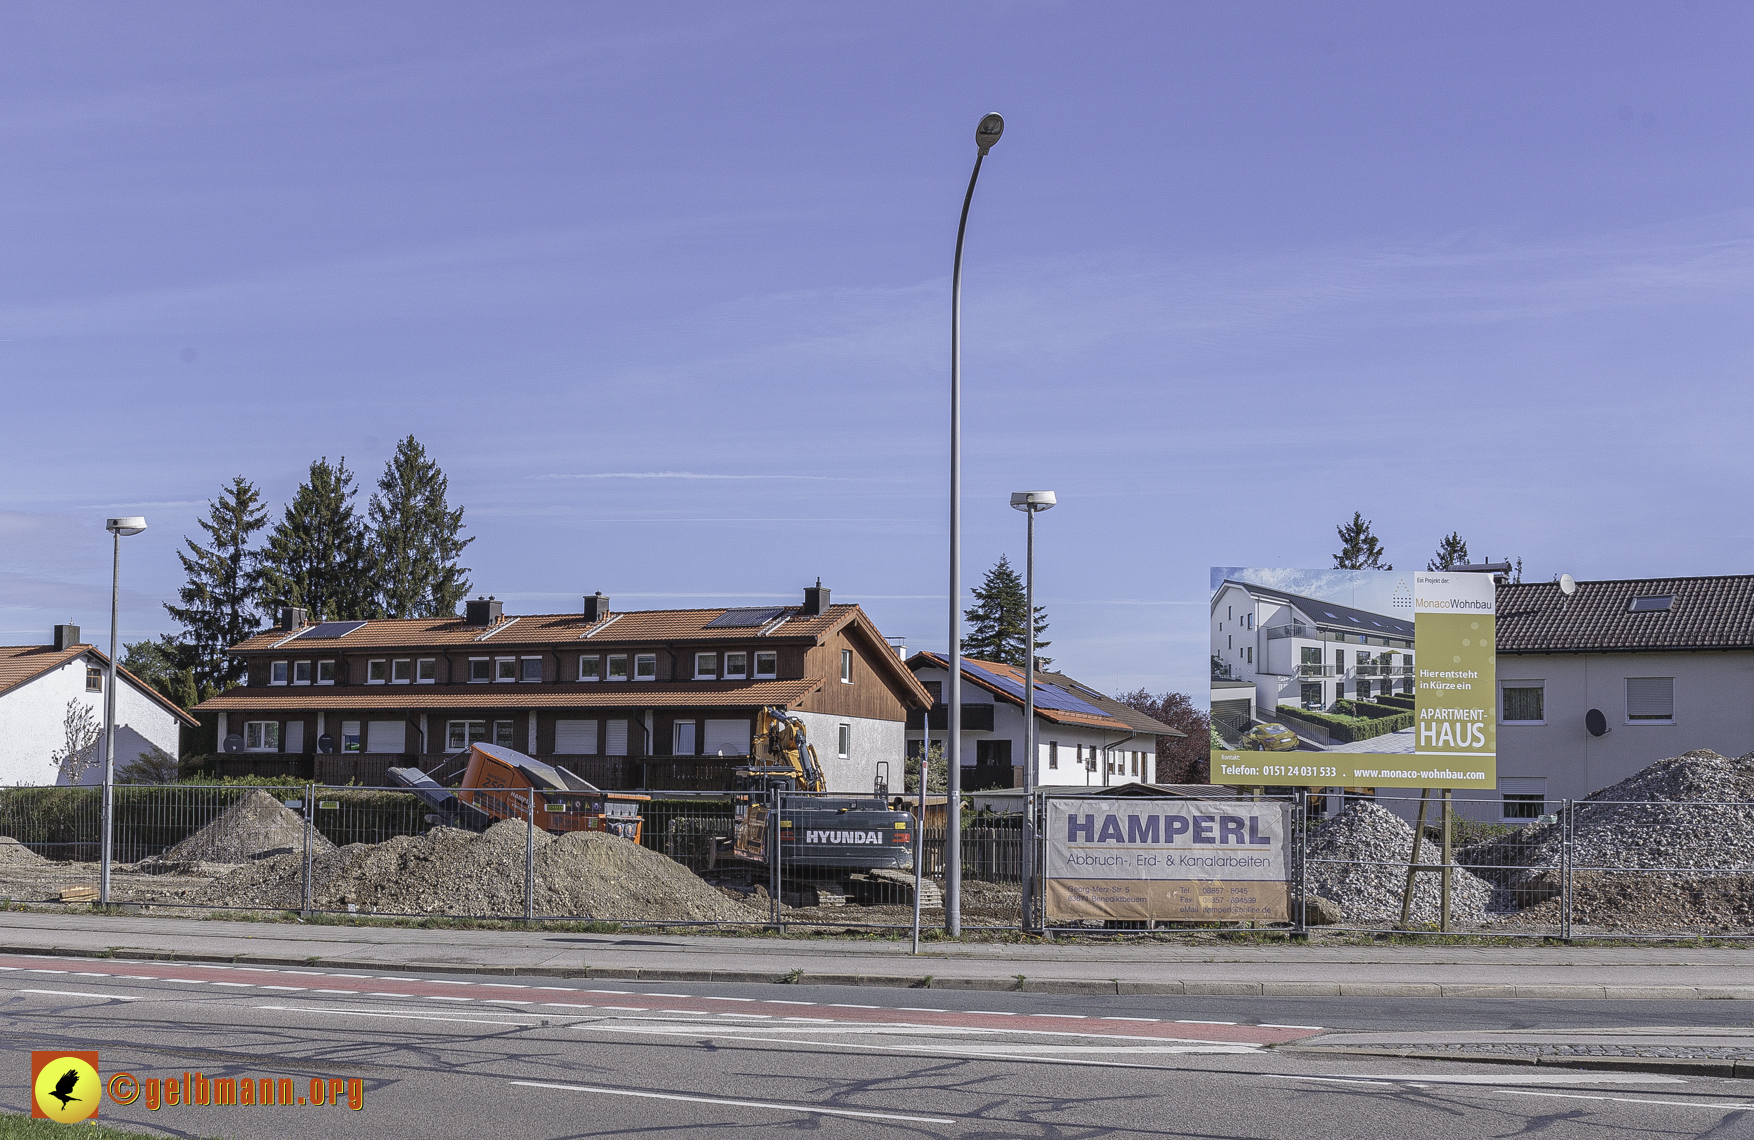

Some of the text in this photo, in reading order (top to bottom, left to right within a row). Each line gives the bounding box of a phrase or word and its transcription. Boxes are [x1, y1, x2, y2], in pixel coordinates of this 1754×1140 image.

[1424, 577, 1440, 585] Projekt
[1415, 598, 1492, 609] MonacoWohnbau
[1419, 669, 1478, 679] Hier entsteht
[1419, 680, 1472, 690] in Kürze ein
[1419, 708, 1488, 721] APARTMENT-
[1420, 721, 1486, 748] HAUS
[1220, 764, 1260, 776] Telefon:
[1263, 765, 1285, 776] 0151
[1287, 766, 1299, 776] 24
[1300, 766, 1317, 777] 031
[1319, 766, 1337, 777] 533
[1353, 768, 1486, 780] www.monaco-wohnbau.com
[1067, 813, 1271, 845] HAMPERL
[806, 830, 883, 845] HYUNDAI
[1066, 853, 1271, 868] Abbruch-, Erd- & Kanalarbeiten
[1091, 895, 1147, 903] Benediktbeuern
